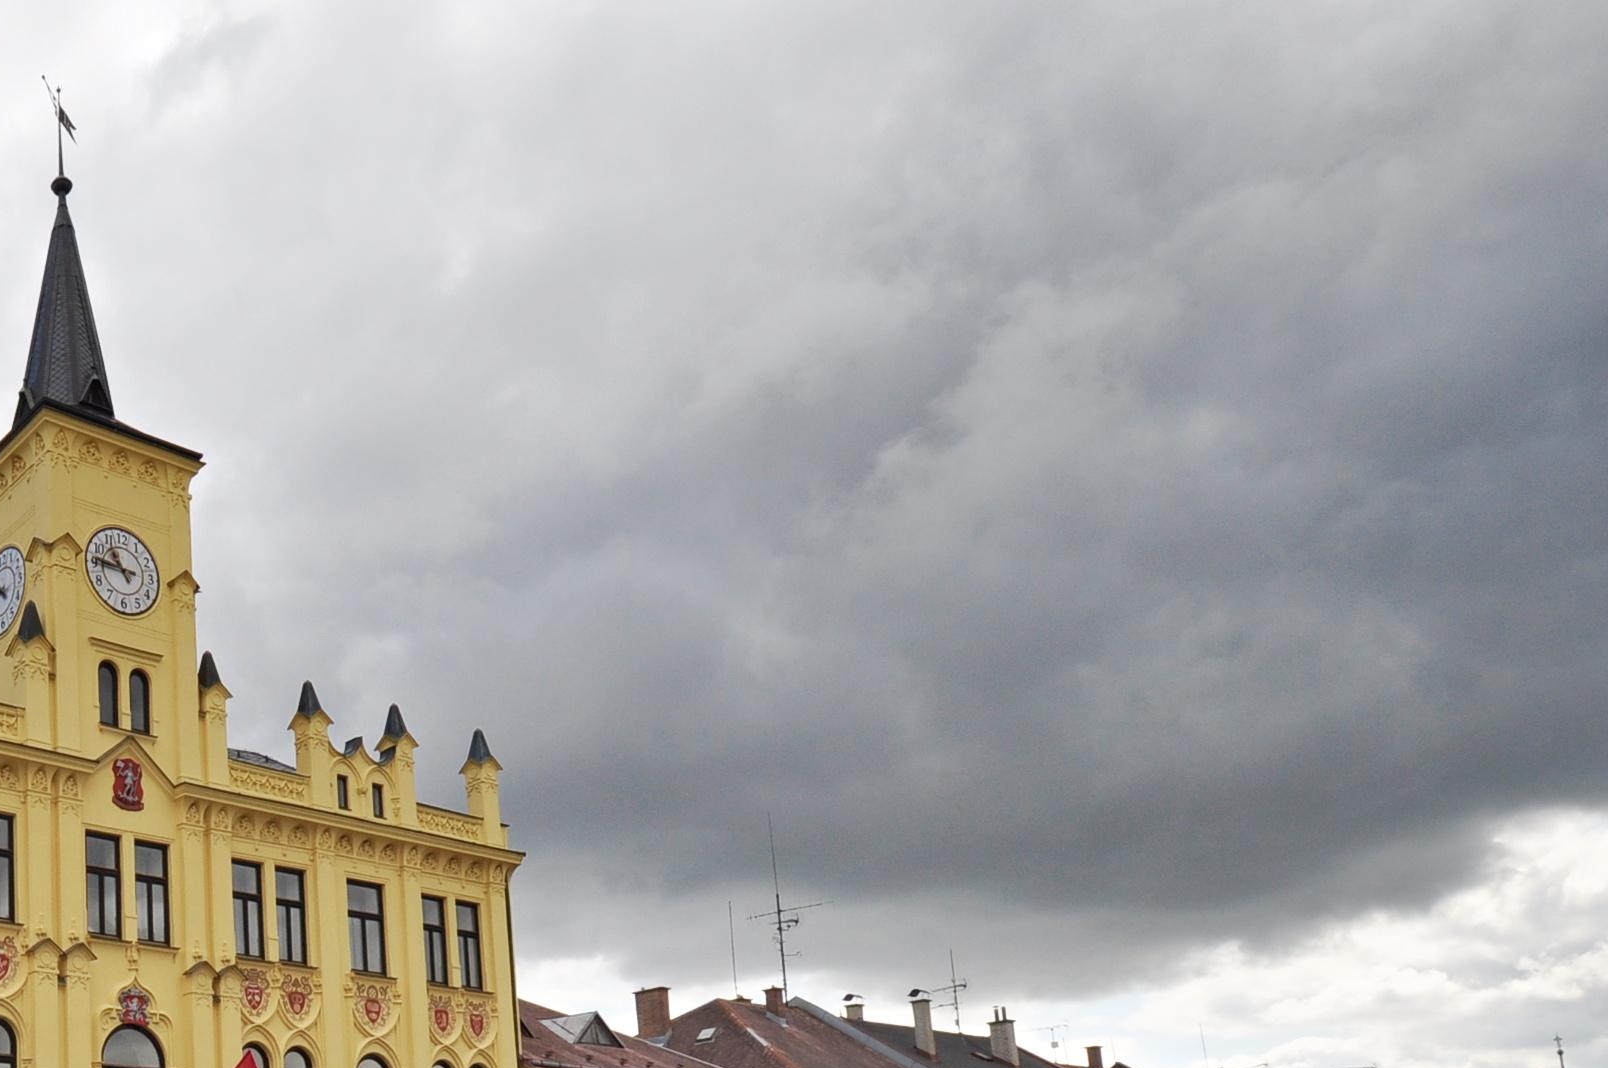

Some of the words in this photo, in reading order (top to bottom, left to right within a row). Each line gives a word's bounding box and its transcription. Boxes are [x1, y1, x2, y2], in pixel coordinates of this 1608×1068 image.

[104, 534, 112, 546] 11
[117, 533, 127, 545] 12
[94, 542, 104, 554] 10
[134, 542, 138, 554] 1
[91, 556, 98, 568] 9
[144, 557, 150, 568] 2
[96, 574, 102, 586] 8
[148, 574, 154, 585] 3
[106, 588, 113, 600] 7
[144, 589, 150, 600] 4
[120, 597, 127, 609] 6
[134, 598, 141, 609] 5
